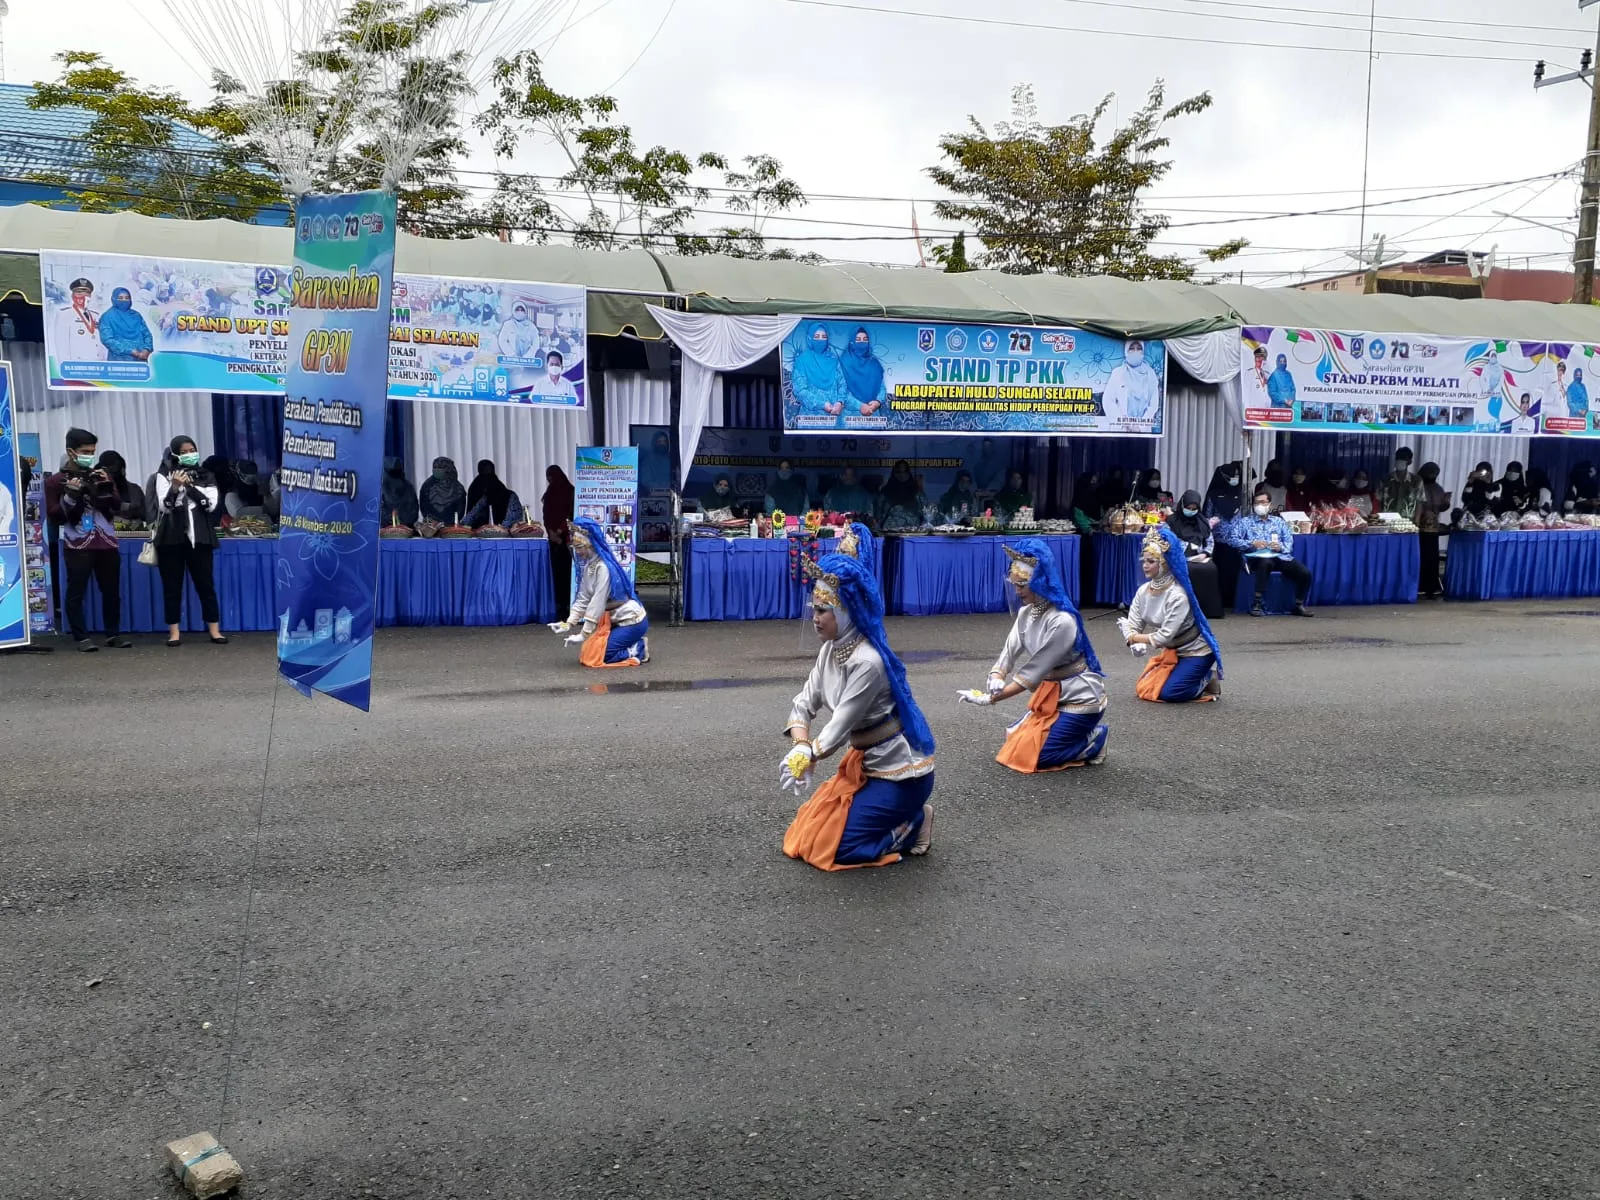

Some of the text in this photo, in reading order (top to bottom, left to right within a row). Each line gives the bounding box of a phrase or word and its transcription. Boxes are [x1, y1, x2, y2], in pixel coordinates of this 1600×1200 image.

[291, 266, 379, 310] Sarasehan
[254, 299, 290, 316] Sar
[177, 315, 232, 333] STAND
[235, 318, 268, 335] UPT
[413, 328, 480, 348] SELATAN
[227, 363, 282, 374] PENINGKATAN
[394, 369, 419, 381] TAHUN
[925, 356, 1067, 385] STAND TP PKK
[1323, 373, 1460, 389] STAND PKBM MELATI
[895, 384, 1093, 401] KABUPATEN HULU SUNGAI SELATAN
[891, 401, 1095, 413] PROGRAM PENINGKATAN KUALITAS HIDUP PEREMPUAN PKH-P
[330, 521, 353, 534] 2020
